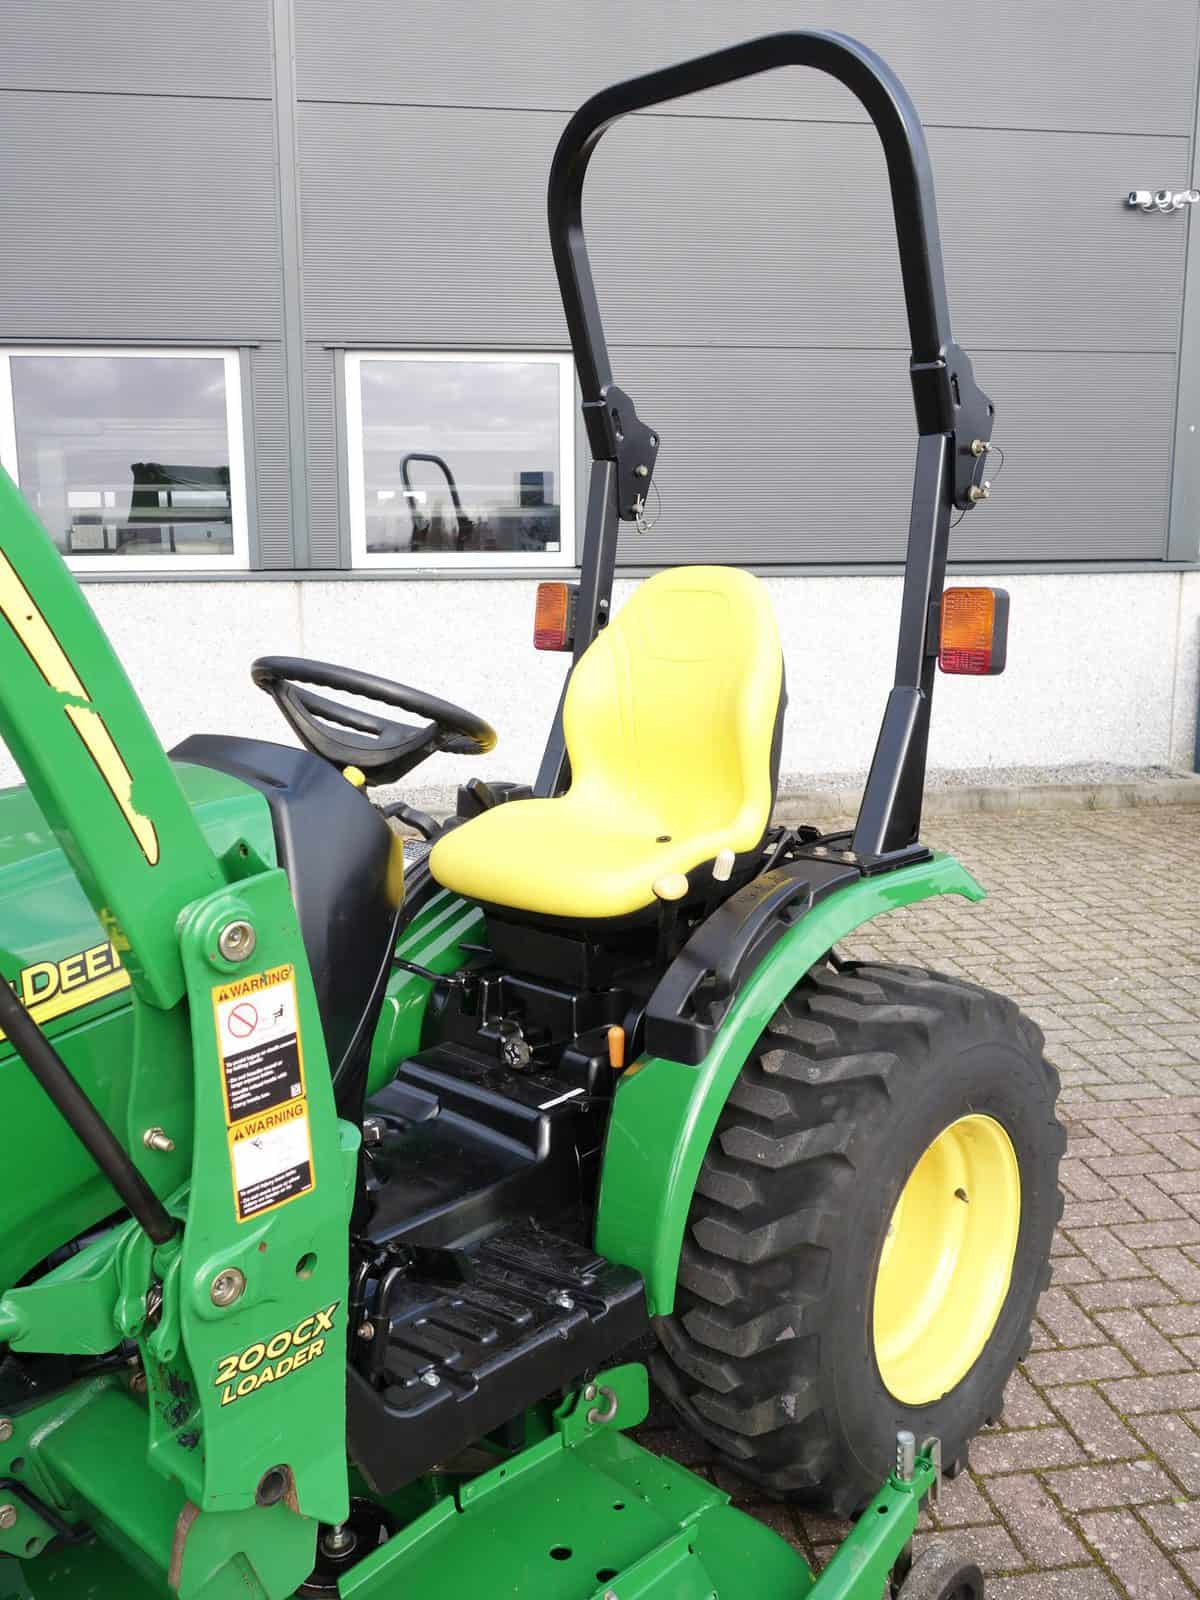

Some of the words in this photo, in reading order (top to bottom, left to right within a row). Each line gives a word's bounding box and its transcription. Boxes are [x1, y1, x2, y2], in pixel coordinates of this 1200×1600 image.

[230, 968, 290, 998] WARNING
[245, 1104, 304, 1137] WARNING
[215, 1301, 341, 1387] 200CX
[221, 1338, 326, 1407] LOADER
